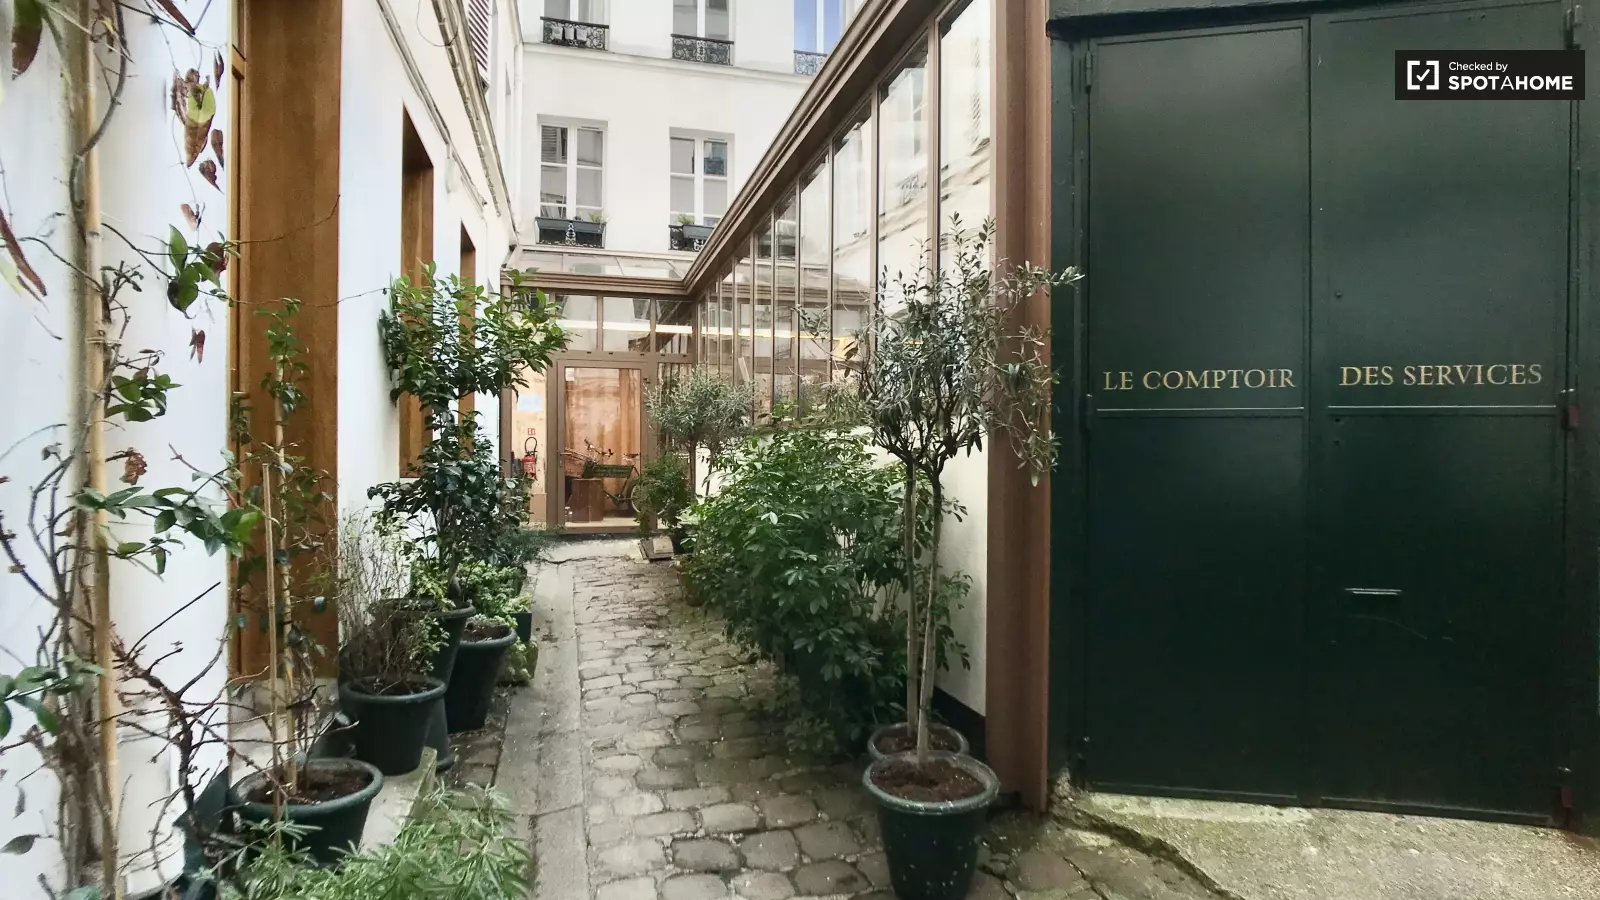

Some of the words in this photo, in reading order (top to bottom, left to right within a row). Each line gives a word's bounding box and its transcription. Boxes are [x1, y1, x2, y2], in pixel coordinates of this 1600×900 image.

[1103, 371, 1134, 391] LE
[1142, 368, 1296, 390] COMPTOIR
[1339, 365, 1395, 386] DES
[1403, 363, 1543, 386] SERVICES
